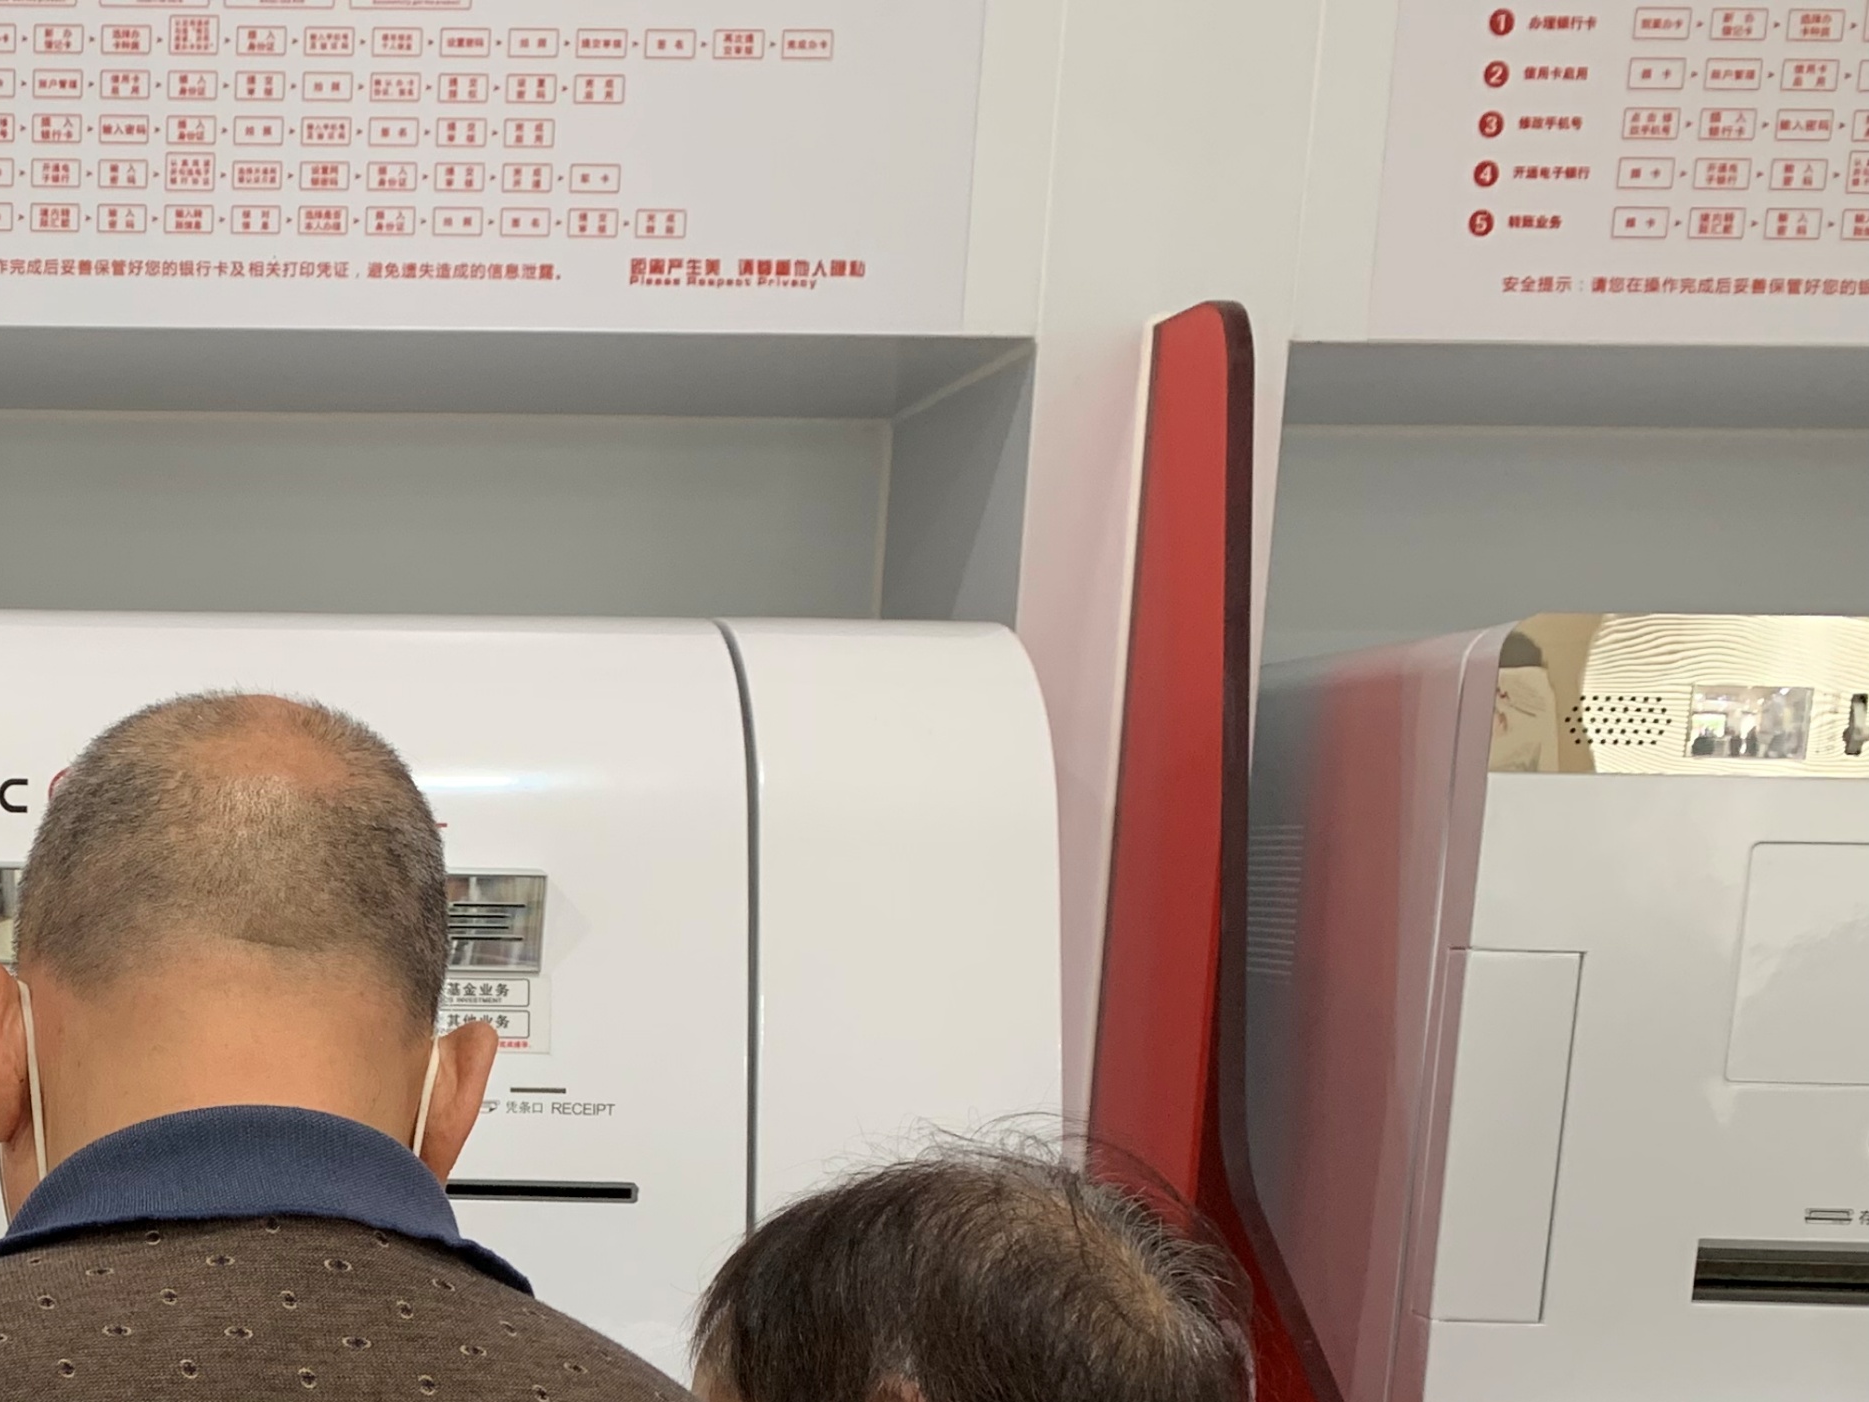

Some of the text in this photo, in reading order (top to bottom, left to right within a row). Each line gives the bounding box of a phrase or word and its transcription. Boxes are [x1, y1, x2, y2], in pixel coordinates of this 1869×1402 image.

[1529, 16, 1597, 30] 办理银行卡
[1523, 66, 1589, 81] 信用卡启用
[1519, 116, 1583, 130] 修改手机号
[1513, 165, 1590, 180] 开通电子银行
[1508, 215, 1562, 229] 转账业务
[757, 276, 817, 289] Privacy
[506, 1100, 616, 1117] 凭条口 RECEIPT
